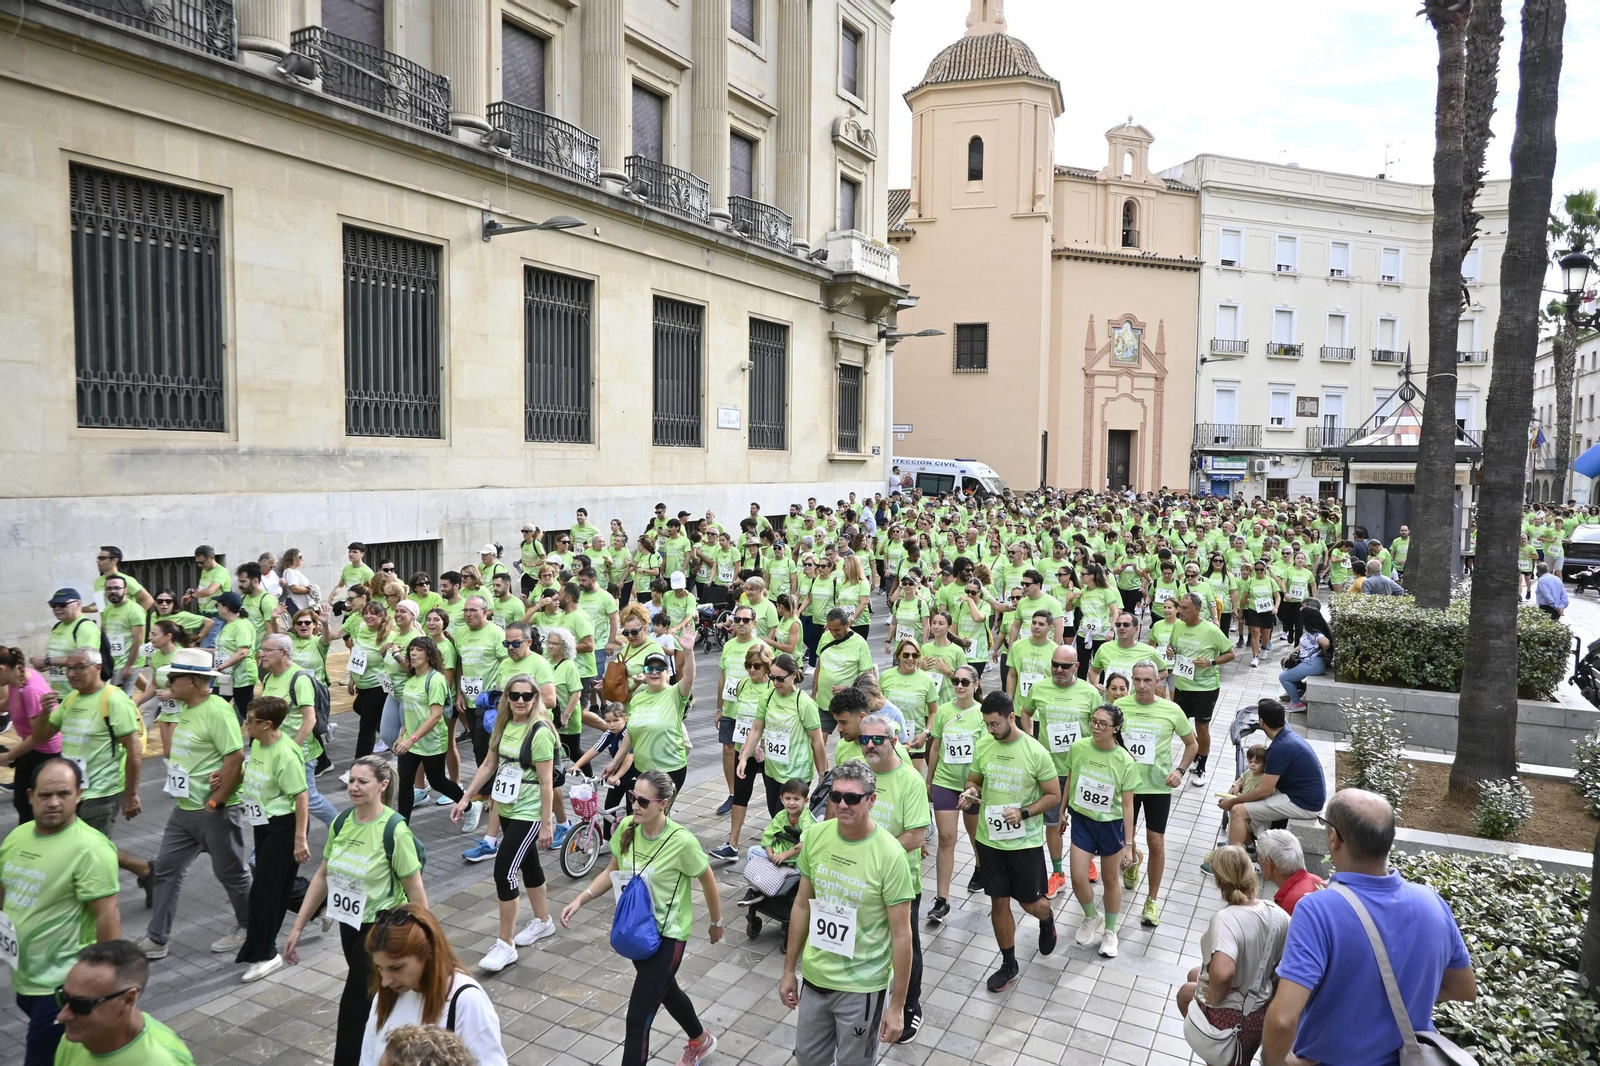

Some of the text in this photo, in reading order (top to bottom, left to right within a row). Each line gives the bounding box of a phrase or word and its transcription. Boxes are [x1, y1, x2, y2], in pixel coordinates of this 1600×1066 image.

[1373, 472, 1403, 481] BURGUER
[351, 657, 364, 668] 444
[464, 685, 480, 695] 396
[1054, 733, 1077, 746] 547
[987, 762, 1024, 775] En marcha
[987, 771, 1013, 782] contra
[987, 780, 1023, 792] cáncer
[817, 863, 867, 889] En marcha
[814, 877, 864, 901] contra el
[333, 892, 361, 915] 906
[816, 918, 849, 942] 907
